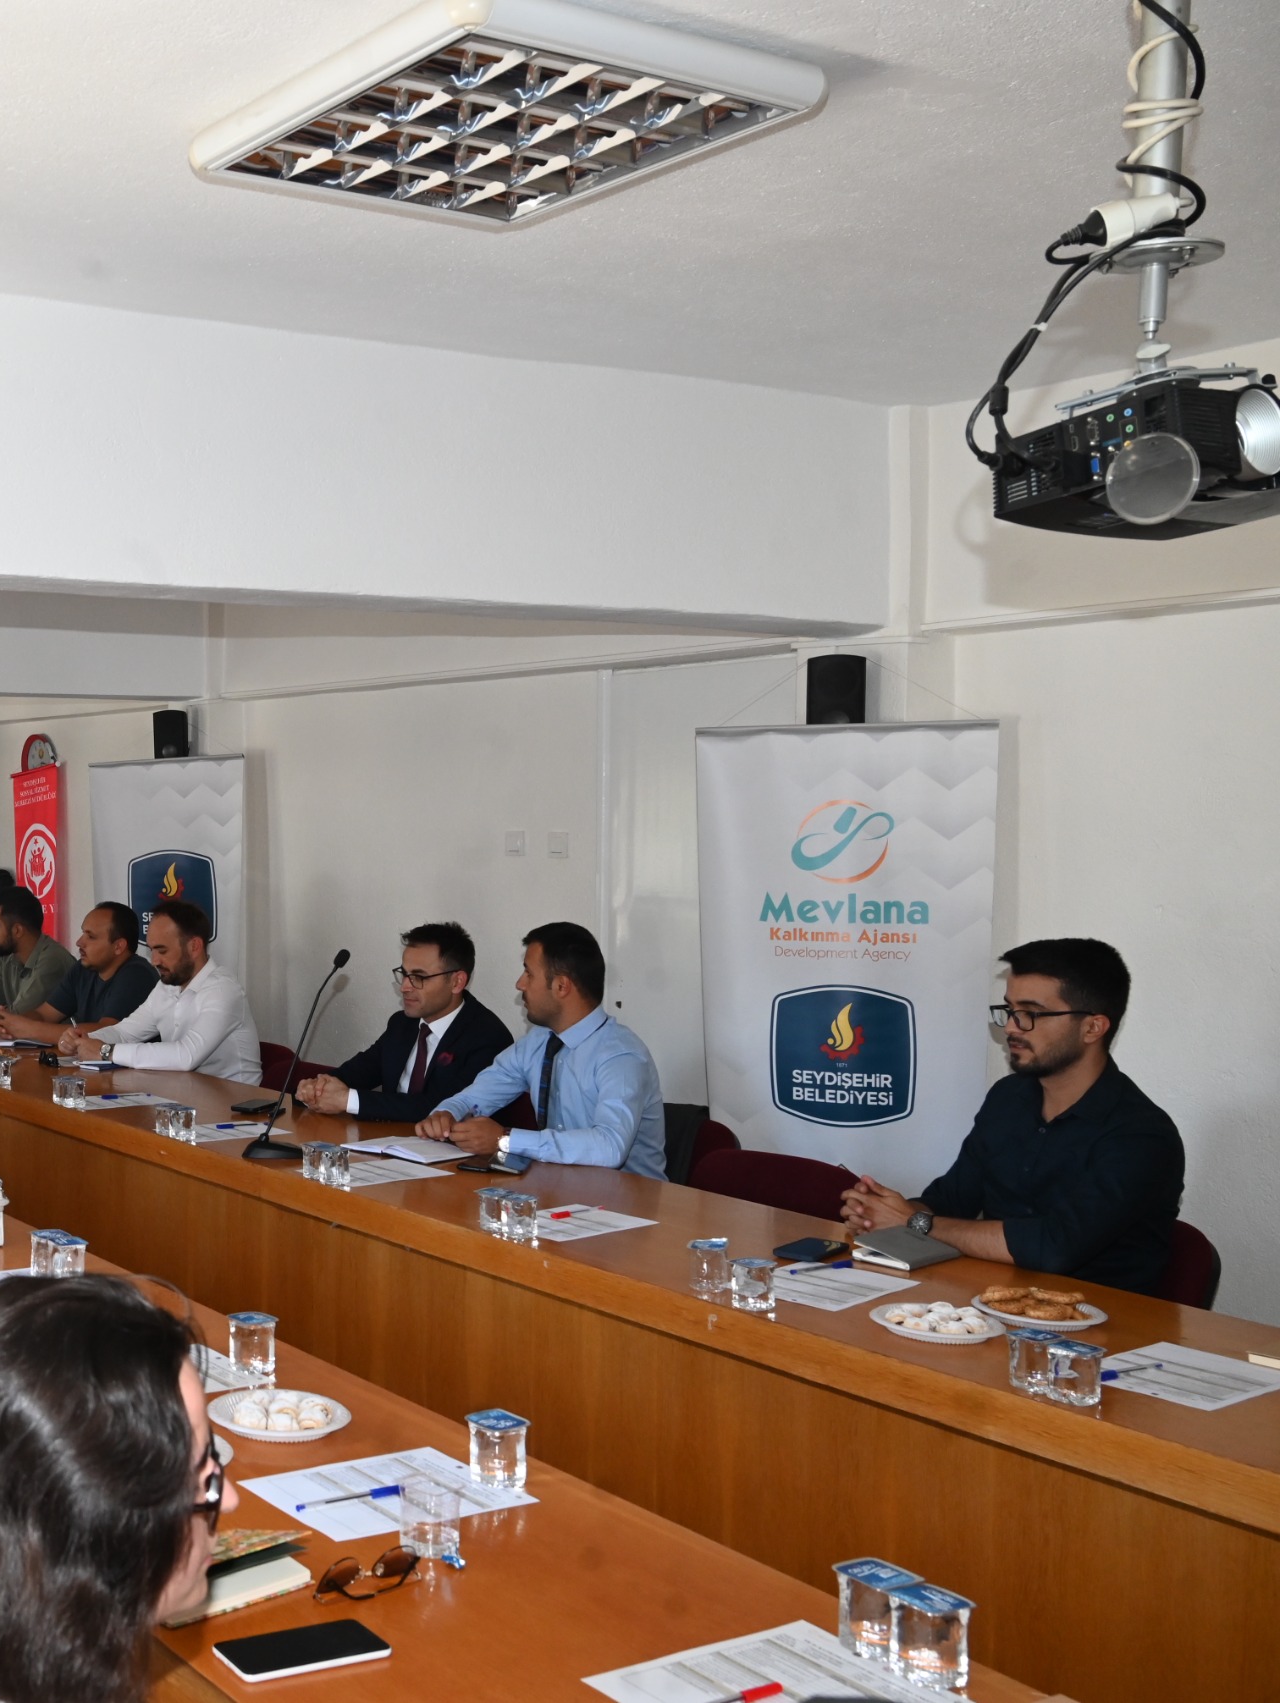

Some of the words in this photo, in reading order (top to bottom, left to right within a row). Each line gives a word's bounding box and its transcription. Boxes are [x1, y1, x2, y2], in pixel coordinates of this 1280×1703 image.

[759, 891, 929, 925] Mevlana
[769, 927, 851, 942] Kalkınma
[857, 929, 918, 946] Ajansı
[774, 945, 858, 960] Development
[861, 948, 911, 962] Agency
